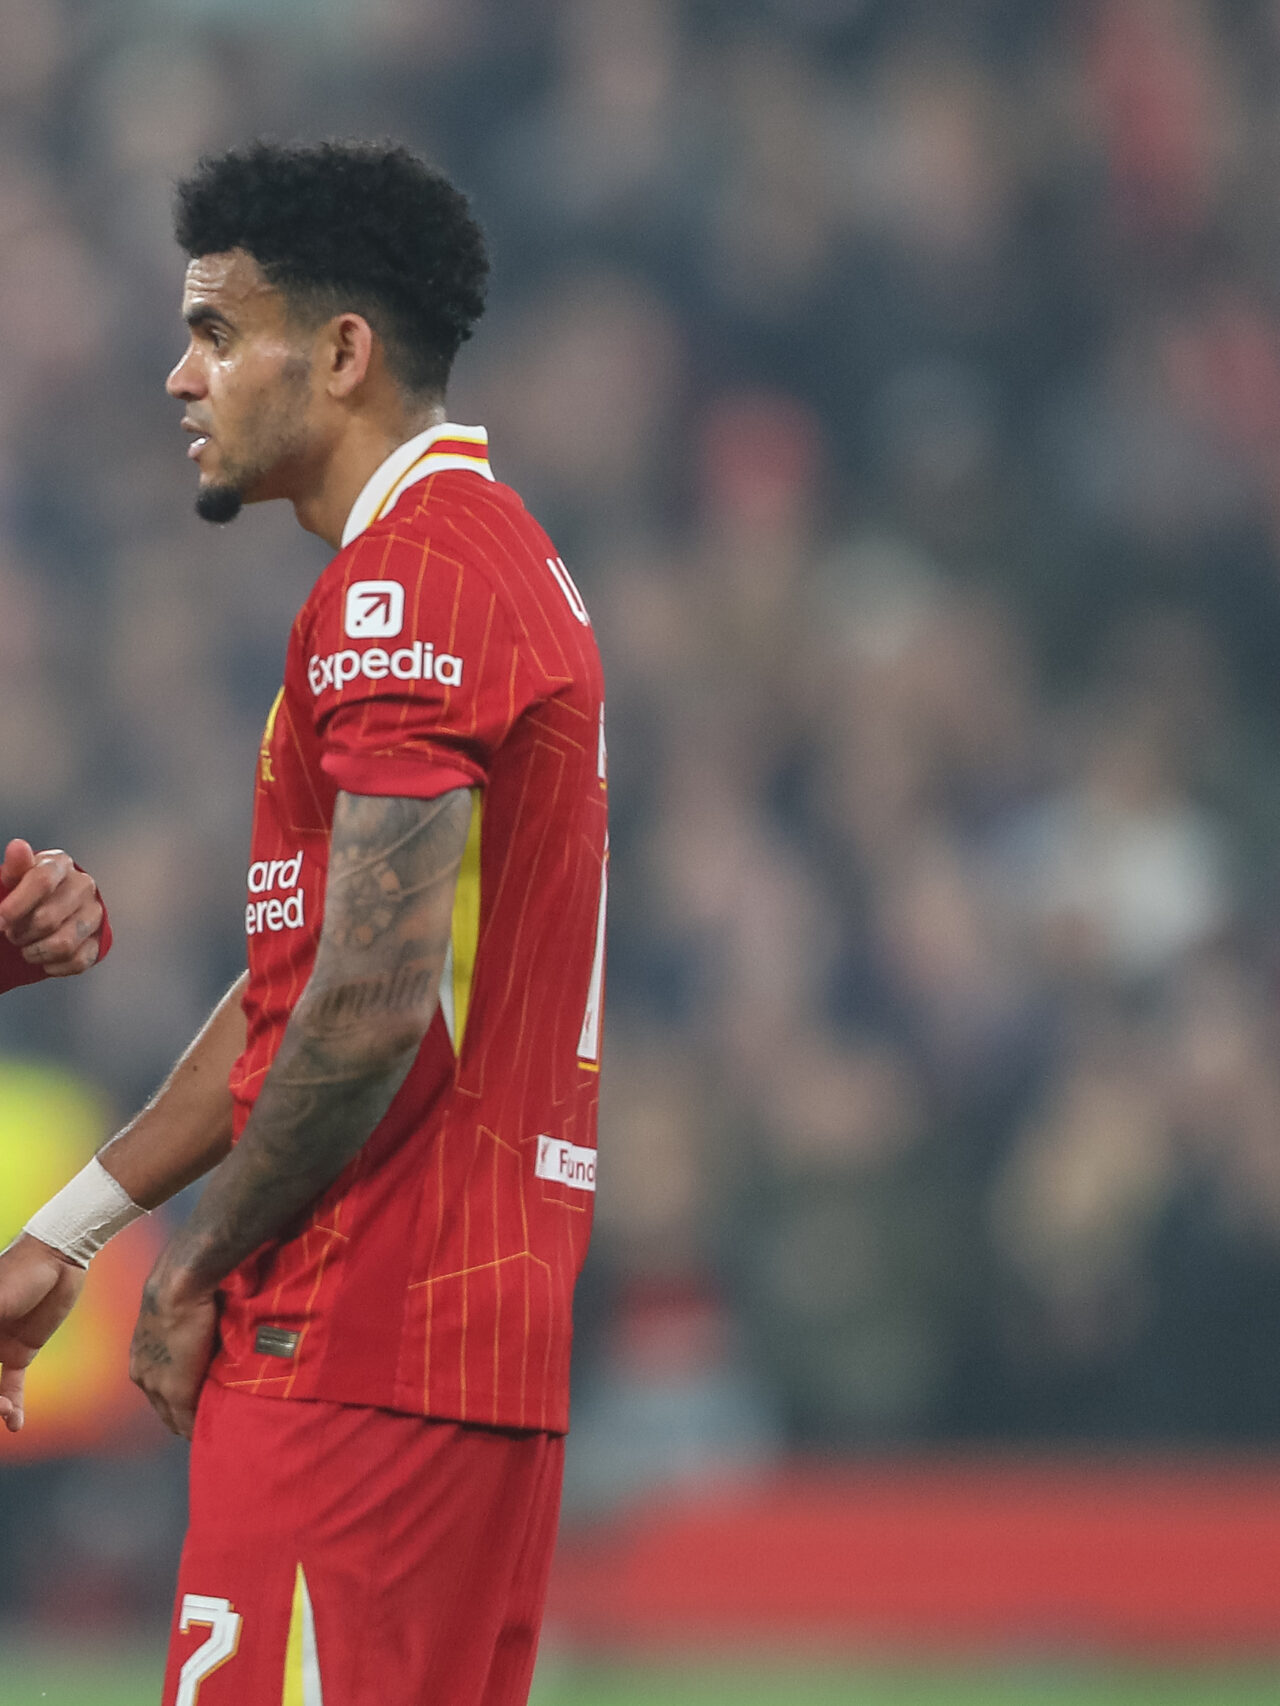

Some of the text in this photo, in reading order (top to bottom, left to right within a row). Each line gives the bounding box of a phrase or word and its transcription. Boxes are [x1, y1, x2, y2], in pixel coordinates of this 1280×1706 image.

[307, 640, 463, 696] Expedia
[247, 850, 304, 893] ard
[245, 888, 304, 935] ered
[175, 1592, 243, 1706] 7
